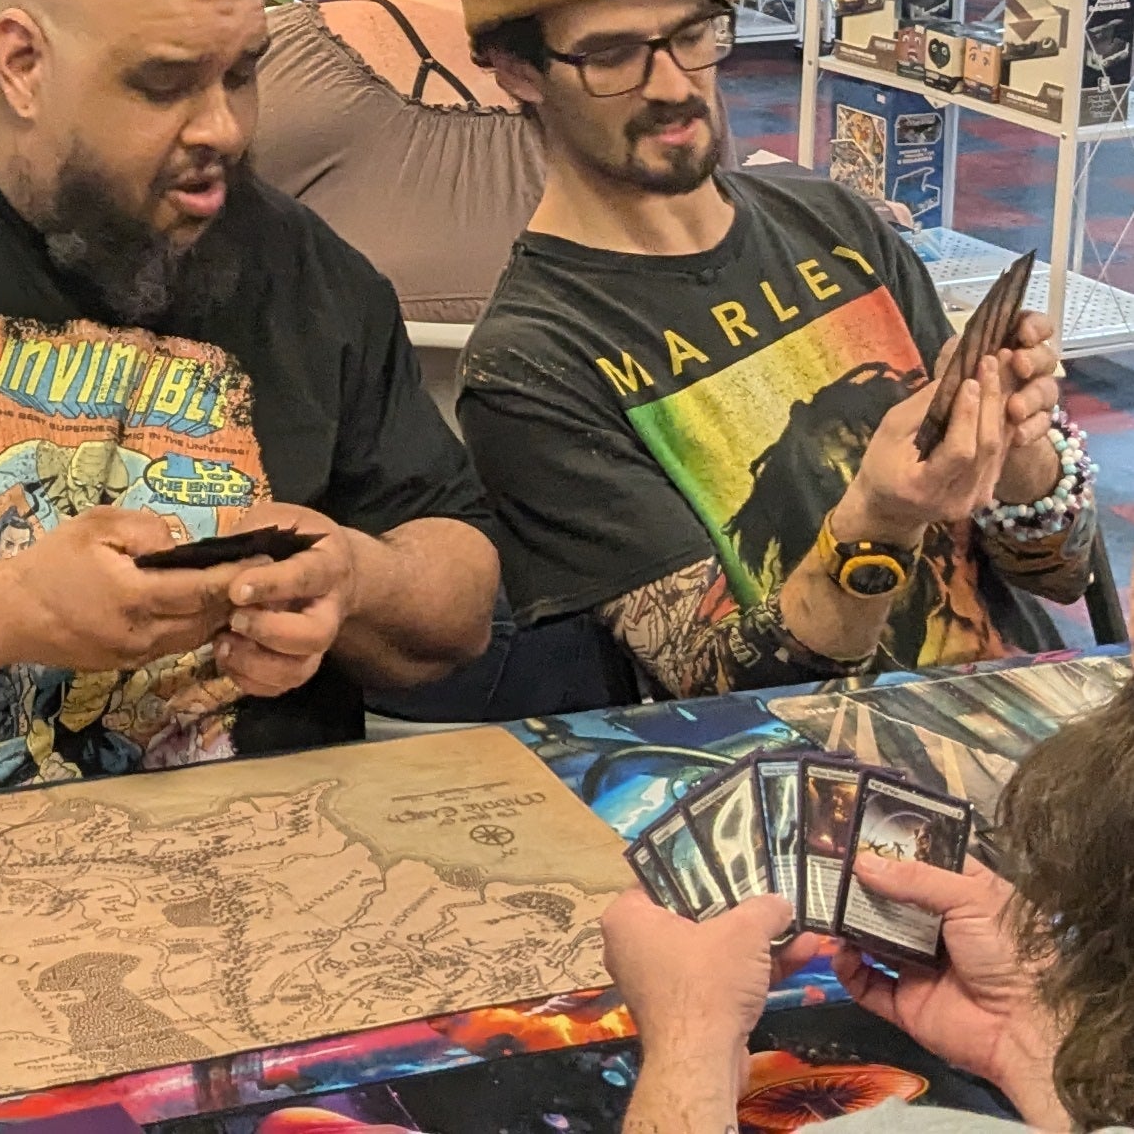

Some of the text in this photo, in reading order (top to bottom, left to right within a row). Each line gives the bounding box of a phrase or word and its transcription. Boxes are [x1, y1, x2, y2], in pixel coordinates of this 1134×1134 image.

[149, 432, 161, 440] IN
[164, 435, 184, 447] THE
[149, 476, 183, 492] THE
[187, 481, 224, 493] END
[149, 491, 180, 504] ALL
